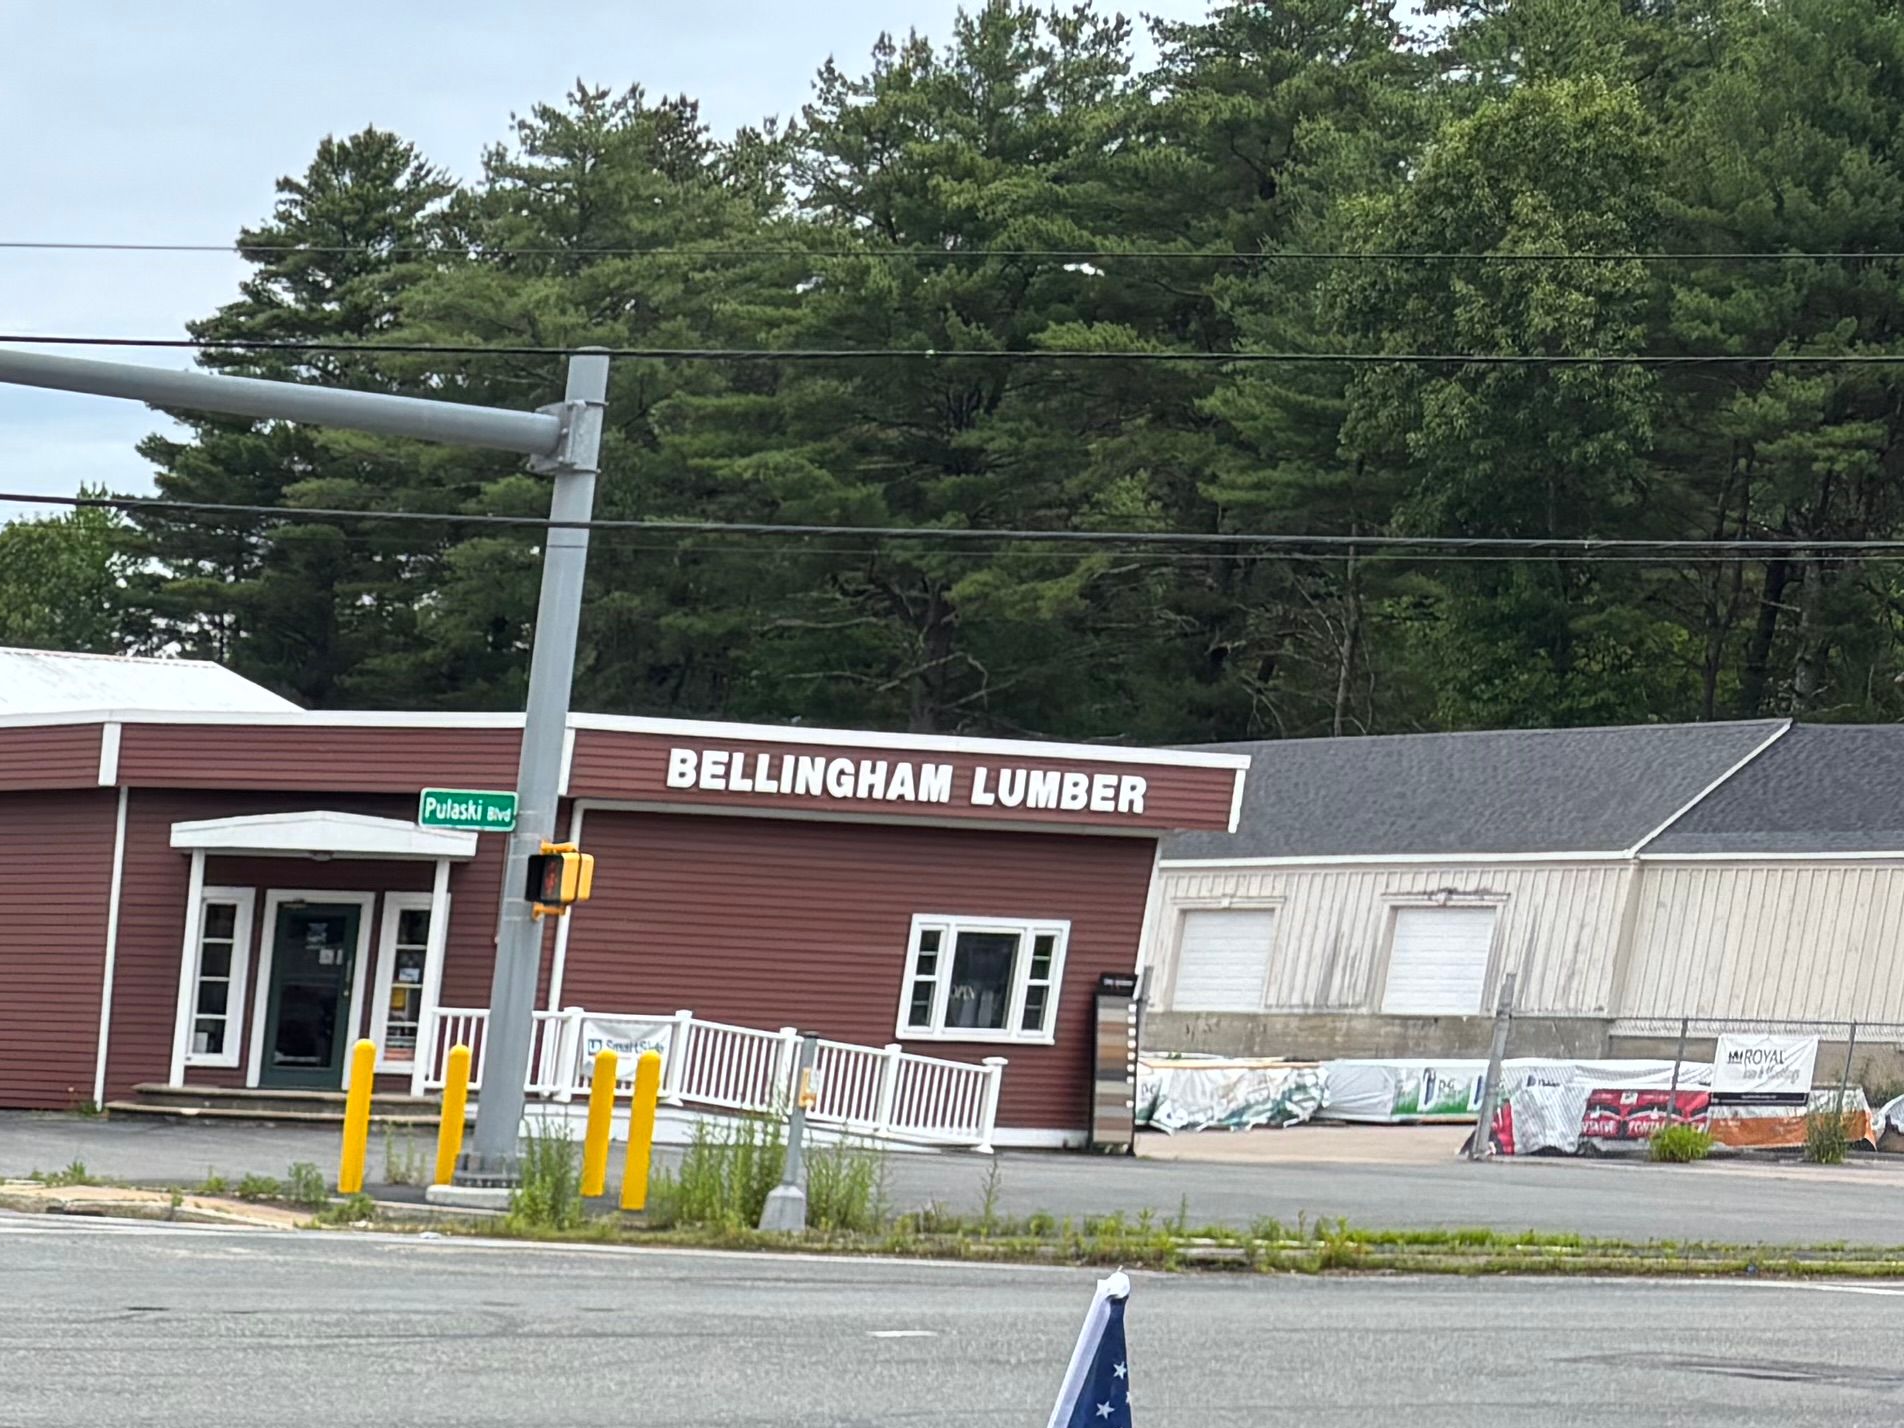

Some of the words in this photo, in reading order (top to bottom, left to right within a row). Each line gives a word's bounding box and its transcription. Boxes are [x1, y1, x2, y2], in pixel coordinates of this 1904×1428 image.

[666, 748, 953, 803] BELLINGHAM
[970, 766, 1147, 814] LUMBER
[425, 797, 483, 821] Pulaski
[486, 806, 512, 822] Blvd
[1744, 1048, 1786, 1065] ROYAL
